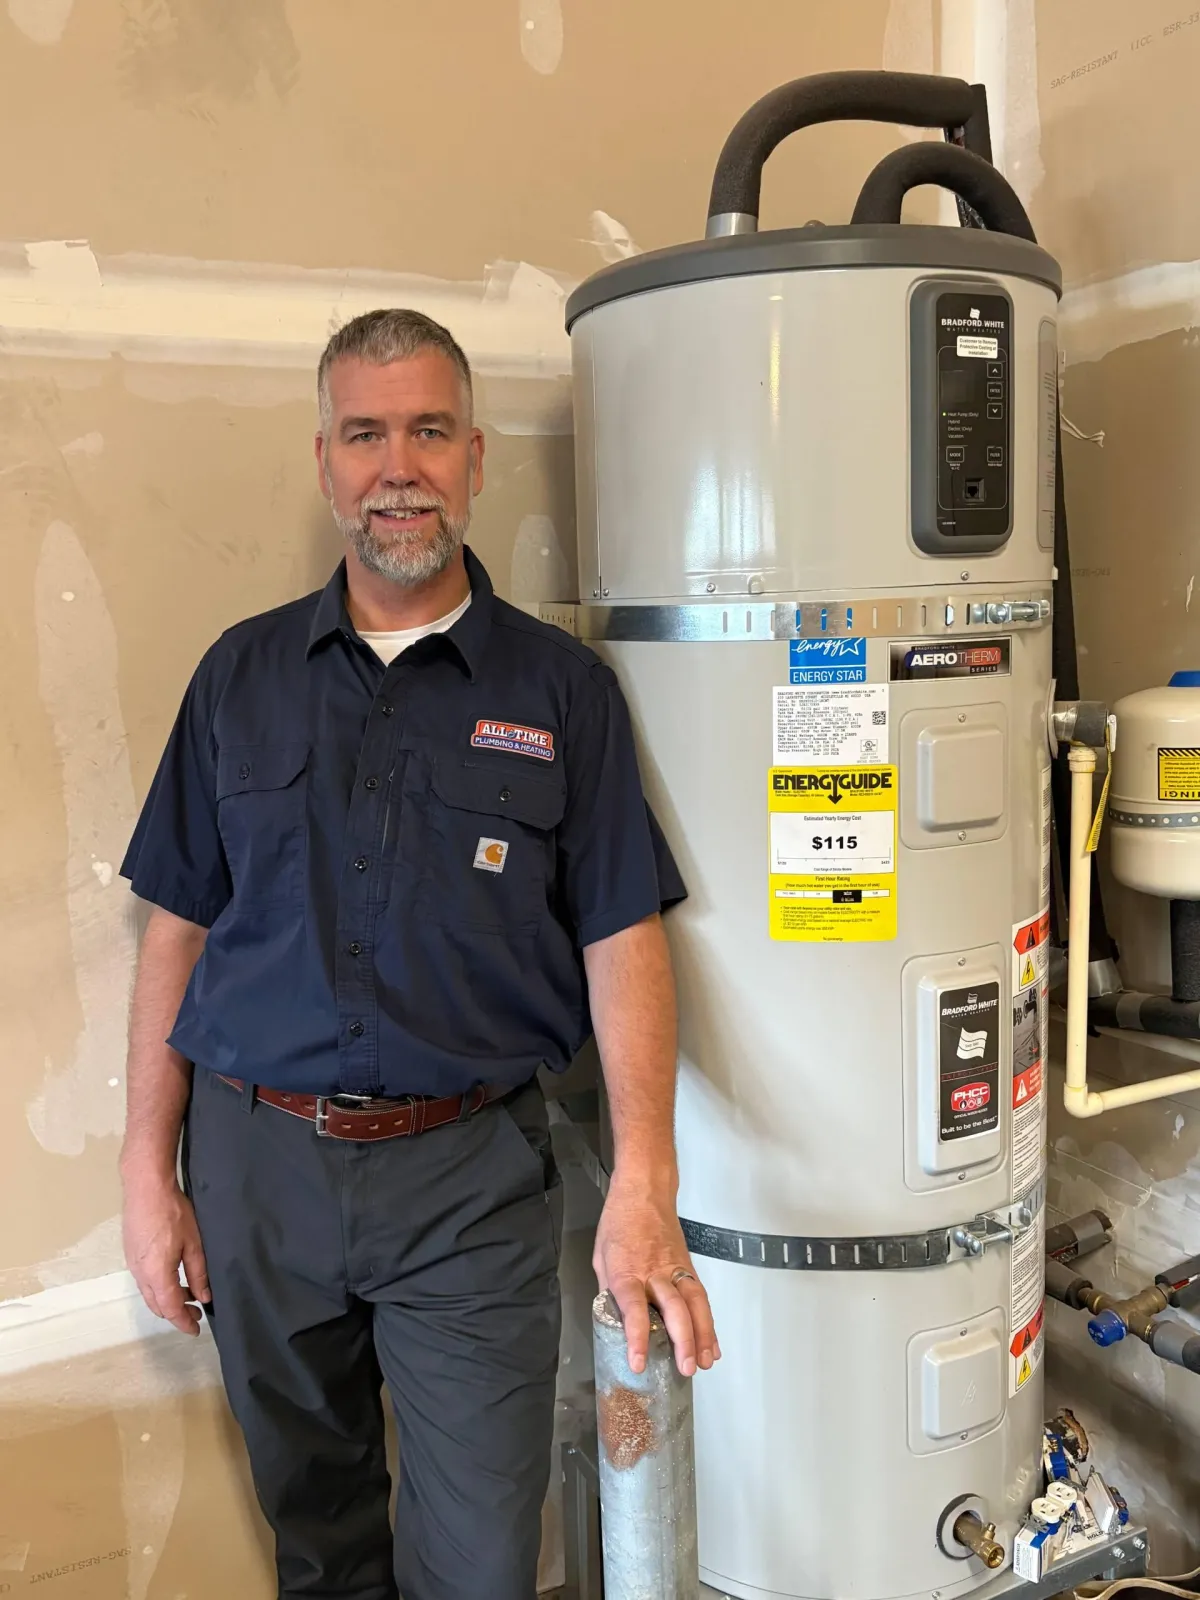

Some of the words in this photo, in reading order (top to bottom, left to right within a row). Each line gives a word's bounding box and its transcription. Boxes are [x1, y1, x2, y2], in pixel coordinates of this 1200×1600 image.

[1050, 50, 1118, 89] SAG-RESISTANT
[941, 318, 982, 327] BRADFORD
[984, 320, 1005, 329] WHITE
[793, 670, 835, 683] ENERGY
[836, 669, 863, 681] STAR
[971, 665, 997, 673] SERIES
[482, 724, 508, 737] ALL
[514, 729, 548, 746] TIME
[475, 736, 514, 749] PLUMBING
[514, 741, 520, 750] &
[520, 743, 551, 757] HEATING
[773, 772, 892, 790] ENERGYGUIDE
[812, 835, 858, 850] $115
[942, 1003, 978, 1016] BRADFORD
[978, 999, 998, 1010] WHITE
[954, 1086, 989, 1101] PHCC
[941, 1126, 955, 1134] Built
[30, 1546, 132, 1584] SAG-RESISTANT
